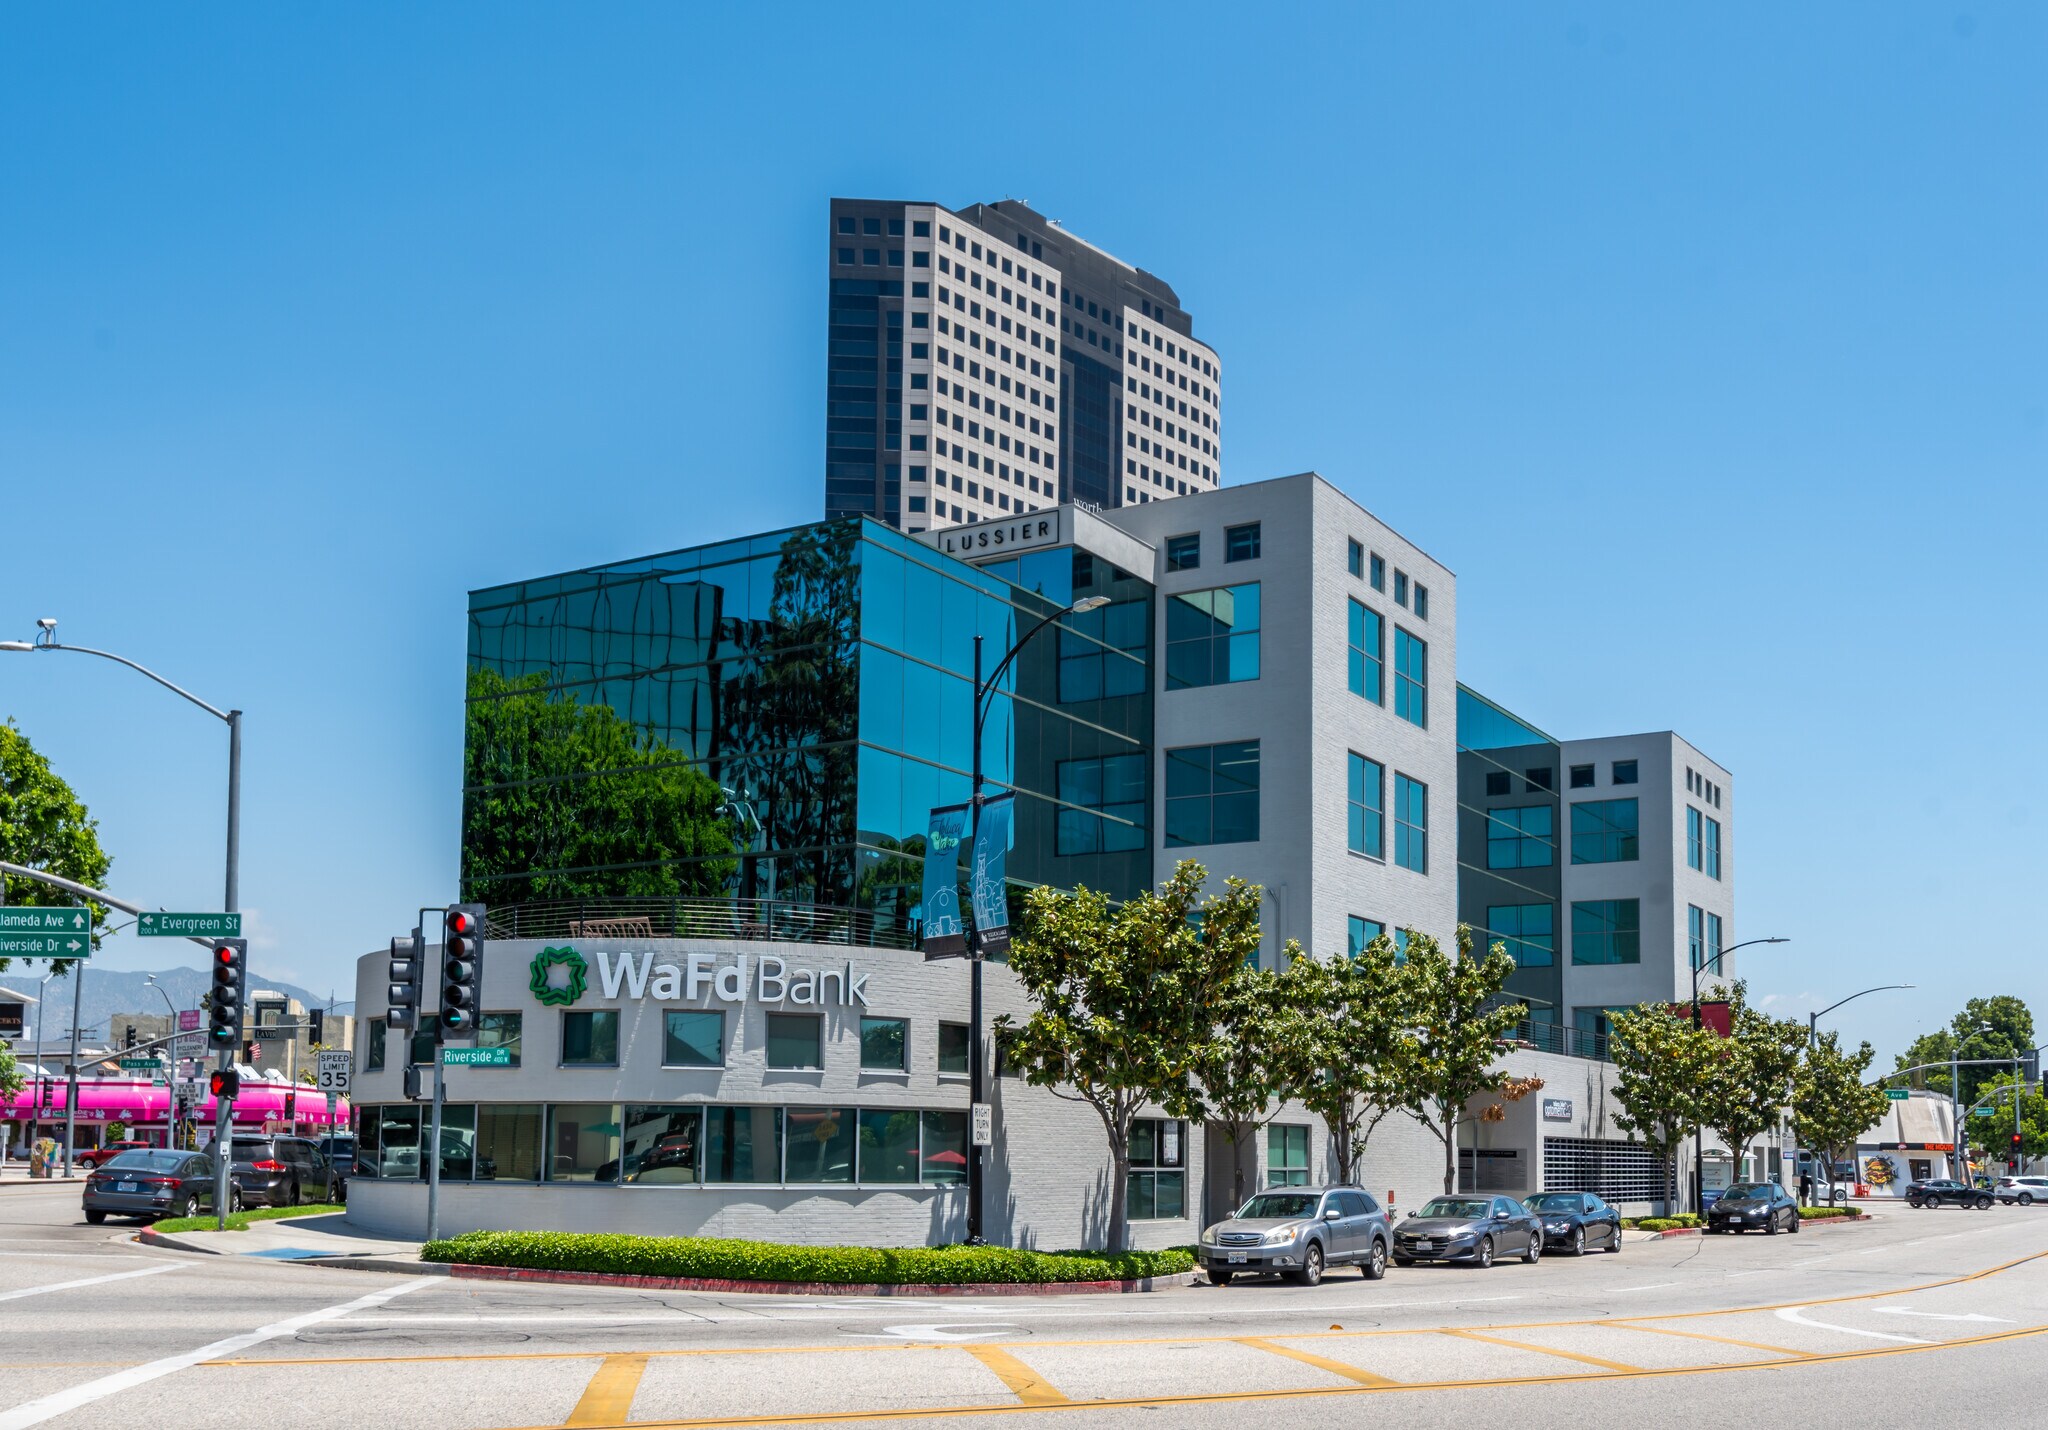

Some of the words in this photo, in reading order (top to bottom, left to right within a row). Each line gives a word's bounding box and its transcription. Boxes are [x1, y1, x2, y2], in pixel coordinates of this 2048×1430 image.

[946, 521, 1049, 553] LUSSIER
[0, 914, 40, 926] lameda
[45, 914, 64, 926] Ave
[162, 916, 220, 933] Evergreen
[225, 916, 238, 929] St
[0, 939, 42, 951] iverside
[48, 939, 60, 951] Dr
[596, 952, 747, 1002] WaFd
[758, 955, 871, 1007] Bank
[444, 1051, 492, 1062] Riverside
[321, 1072, 347, 1087] 35
[975, 1107, 990, 1117] RIGHT
[976, 1119, 989, 1129] TURN
[976, 1131, 988, 1141] ONLY
